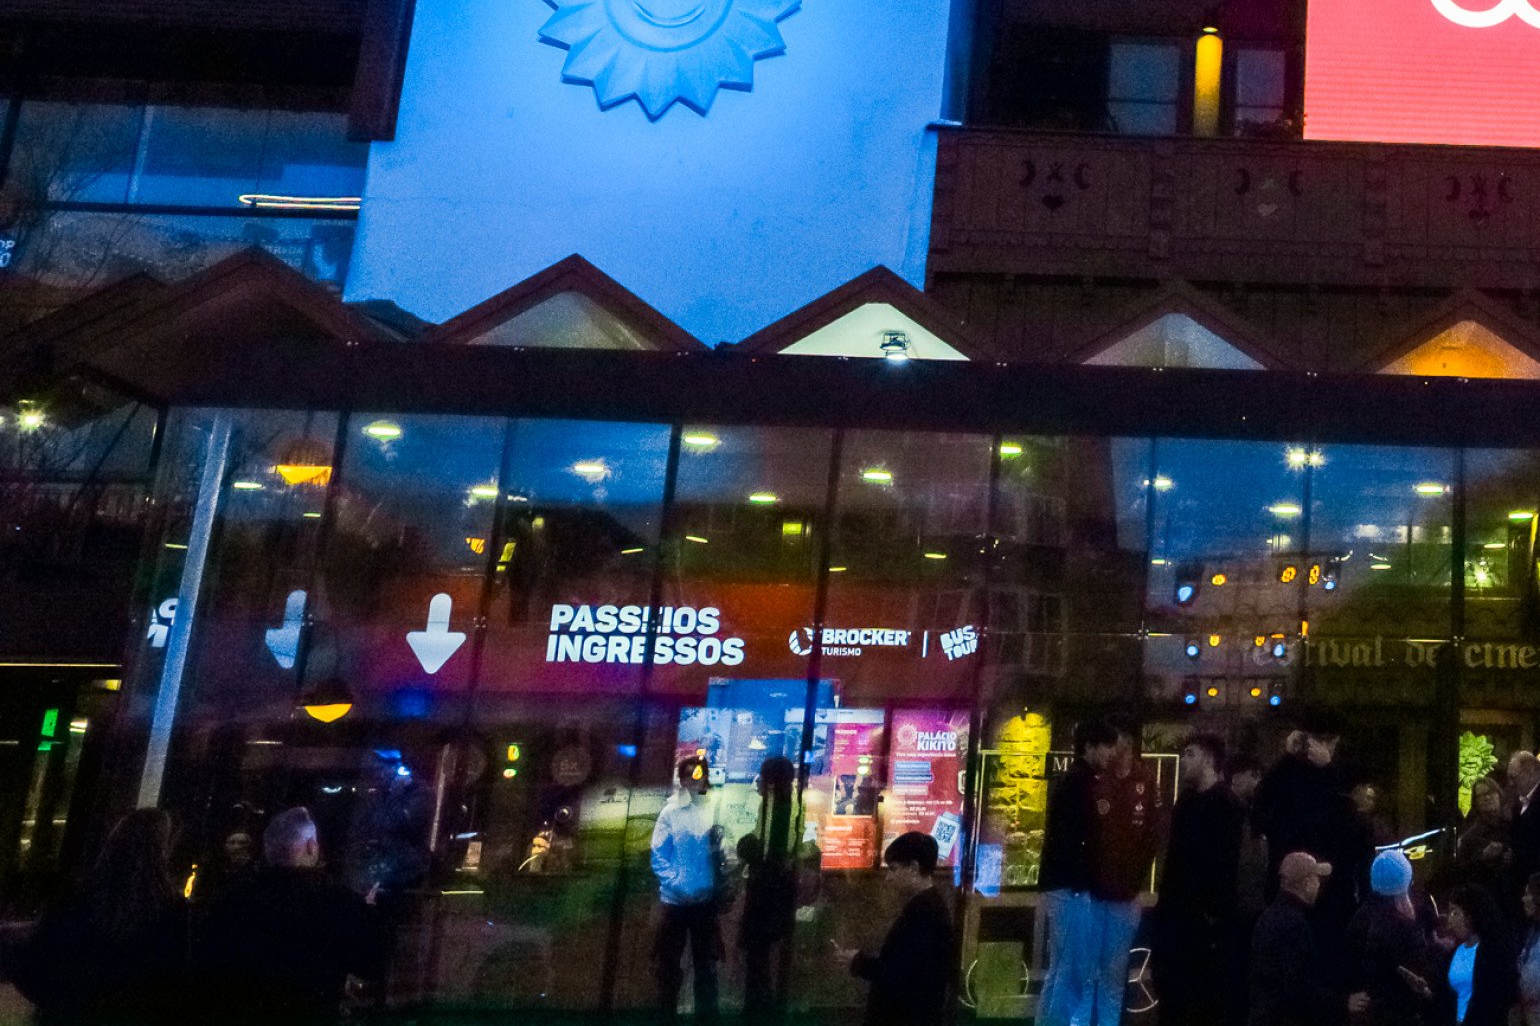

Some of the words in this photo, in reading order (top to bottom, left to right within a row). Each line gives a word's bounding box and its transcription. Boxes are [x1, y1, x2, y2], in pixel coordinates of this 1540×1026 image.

[821, 628, 911, 646] BROCKER
[546, 635, 745, 666] INGRESSOS
[821, 646, 861, 657] TURISMO
[917, 740, 957, 751] KIKITO
